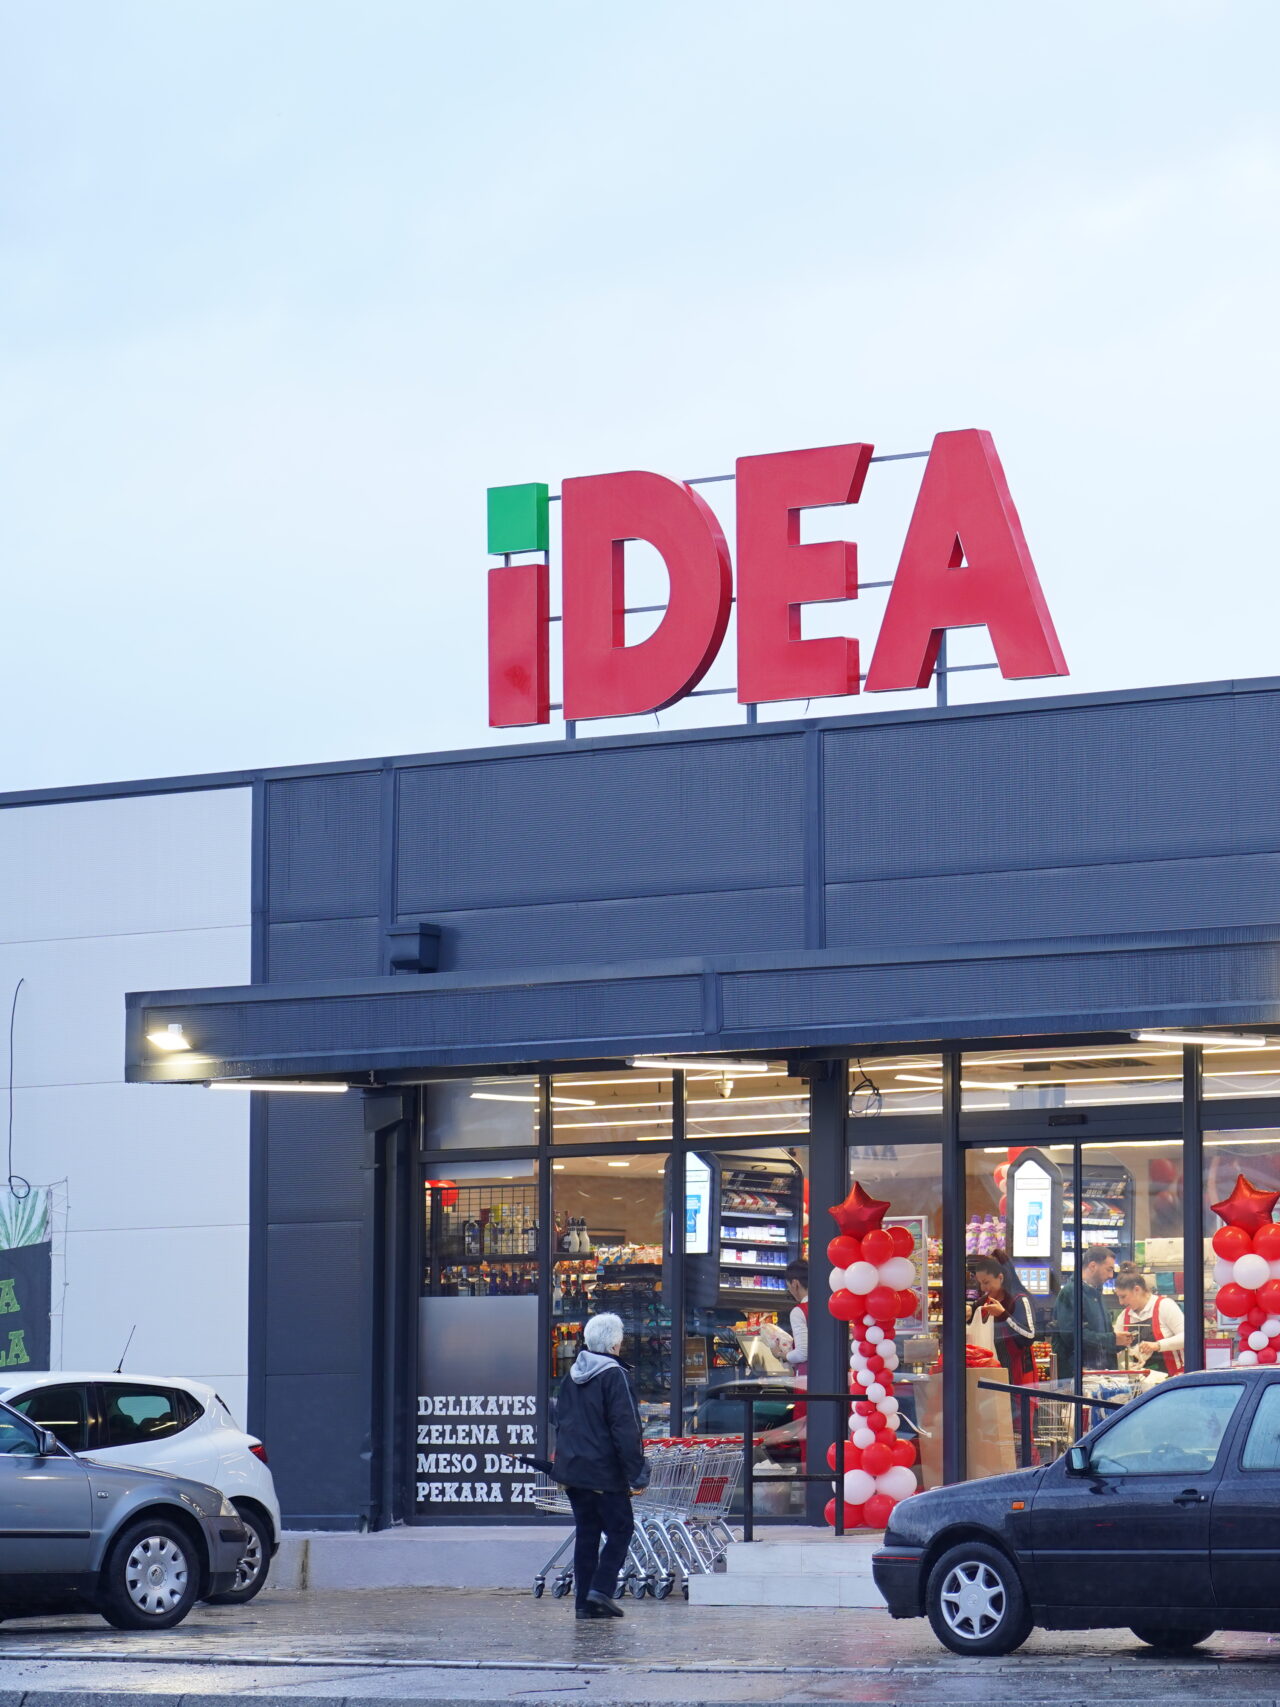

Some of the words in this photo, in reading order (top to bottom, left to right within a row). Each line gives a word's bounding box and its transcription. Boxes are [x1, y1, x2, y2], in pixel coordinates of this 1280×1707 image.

[417, 1396, 536, 1416] DELIKATES
[416, 1424, 500, 1444] ZELENA
[507, 1424, 537, 1444] TR
[416, 1453, 478, 1473] MESO
[416, 1482, 503, 1502] PEKARA
